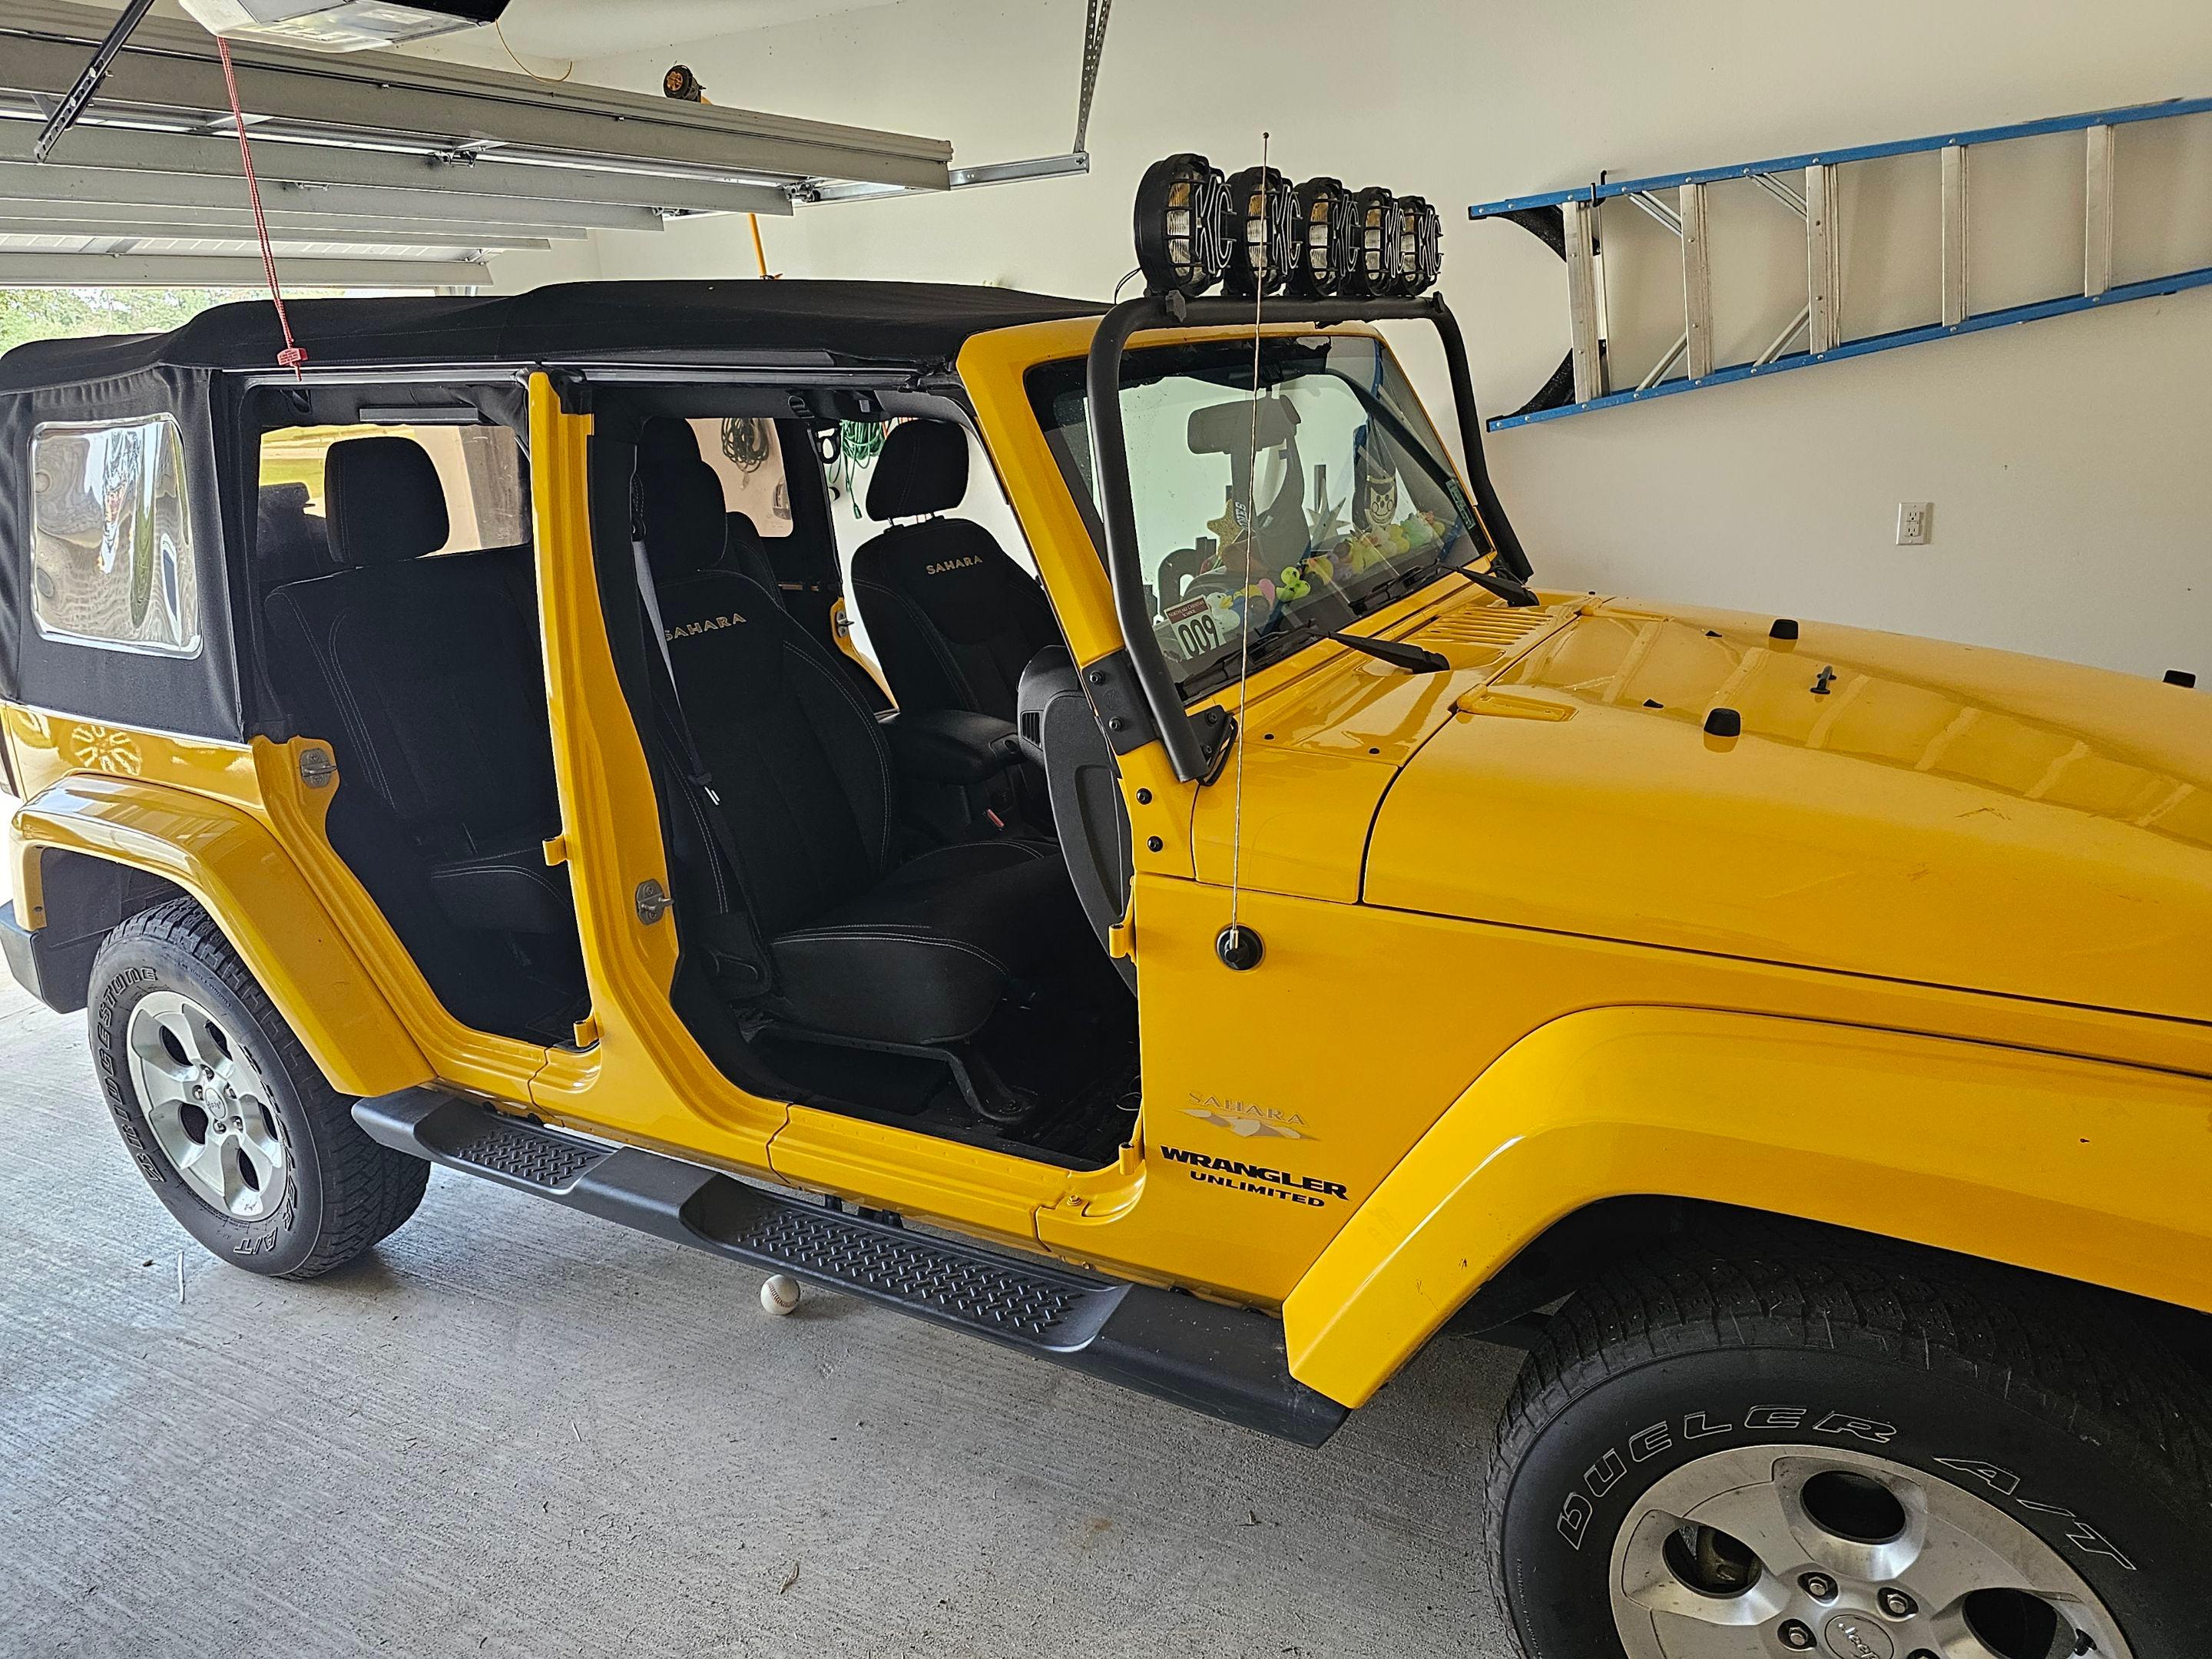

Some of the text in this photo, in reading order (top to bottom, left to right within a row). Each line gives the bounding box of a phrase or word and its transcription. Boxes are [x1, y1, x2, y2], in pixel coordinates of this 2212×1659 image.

[1195, 174, 1233, 274] KC
[1272, 184, 1300, 276] KC
[1332, 194, 1359, 277] KC
[1385, 202, 1406, 278] KC
[1419, 208, 1442, 277] KC
[926, 555, 983, 575] SAHARA
[664, 613, 747, 641] SAHARA
[1178, 614, 1220, 657] 009
[1188, 1091, 1309, 1128] SAHARA
[1160, 1145, 1350, 1200] WRANGLER
[1190, 1171, 1326, 1207] UNLIMITED
[1557, 1405, 2137, 1571] DUELER A/T
